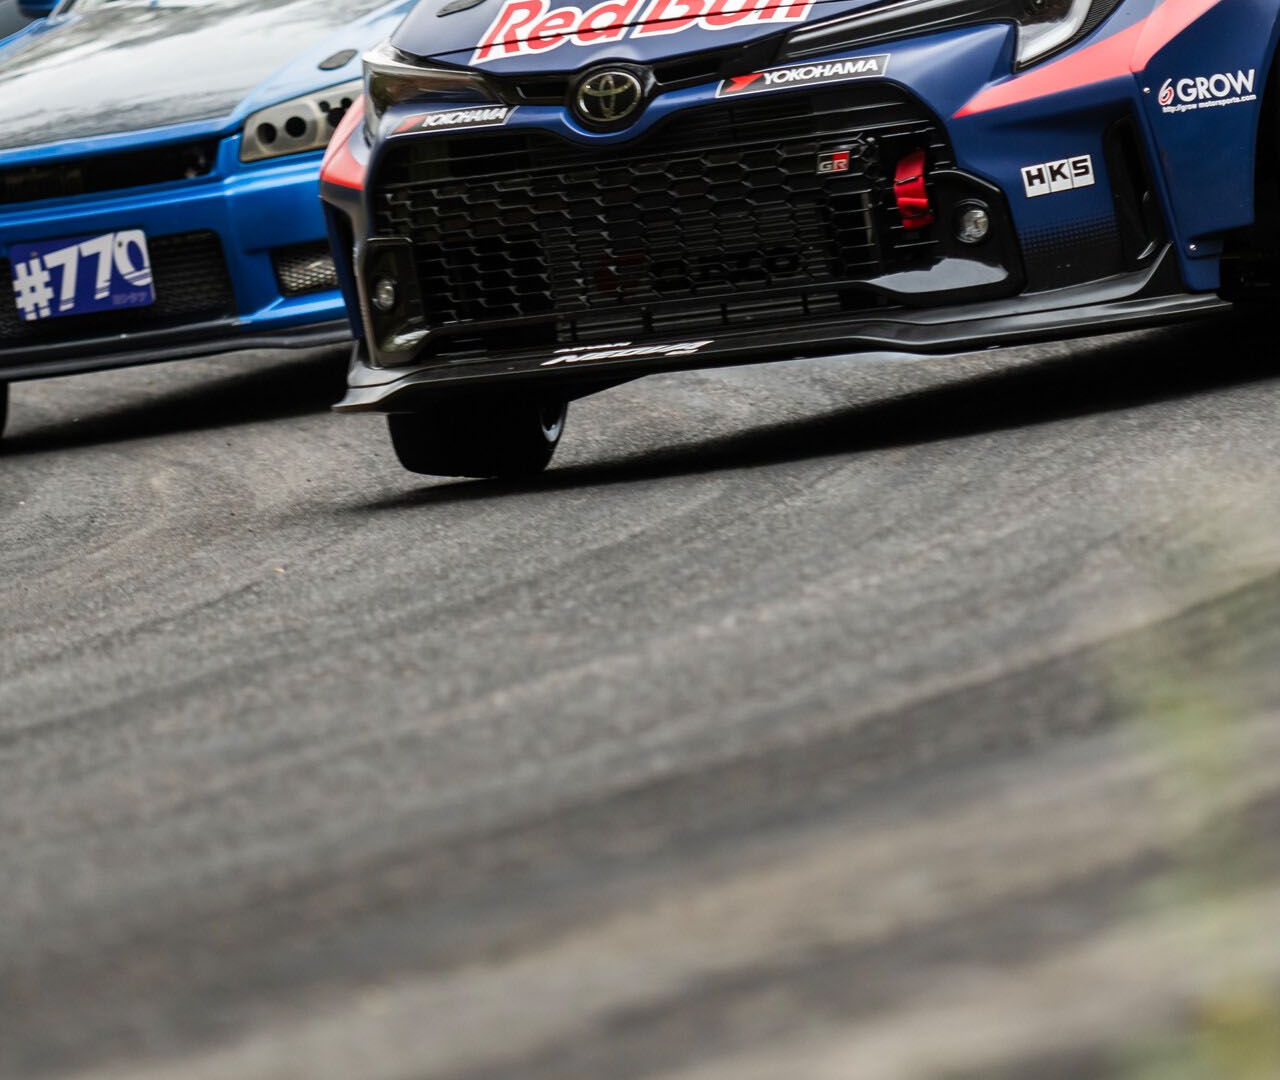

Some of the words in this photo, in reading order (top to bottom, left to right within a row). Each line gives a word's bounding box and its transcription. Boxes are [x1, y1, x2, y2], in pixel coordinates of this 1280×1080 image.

[762, 59, 879, 85] YOKOHAMA
[1177, 69, 1255, 102] GROW
[422, 106, 507, 128] YOKOHAMA
[819, 154, 849, 172] GR
[1024, 158, 1091, 187] HKS
[12, 229, 154, 321] #770
